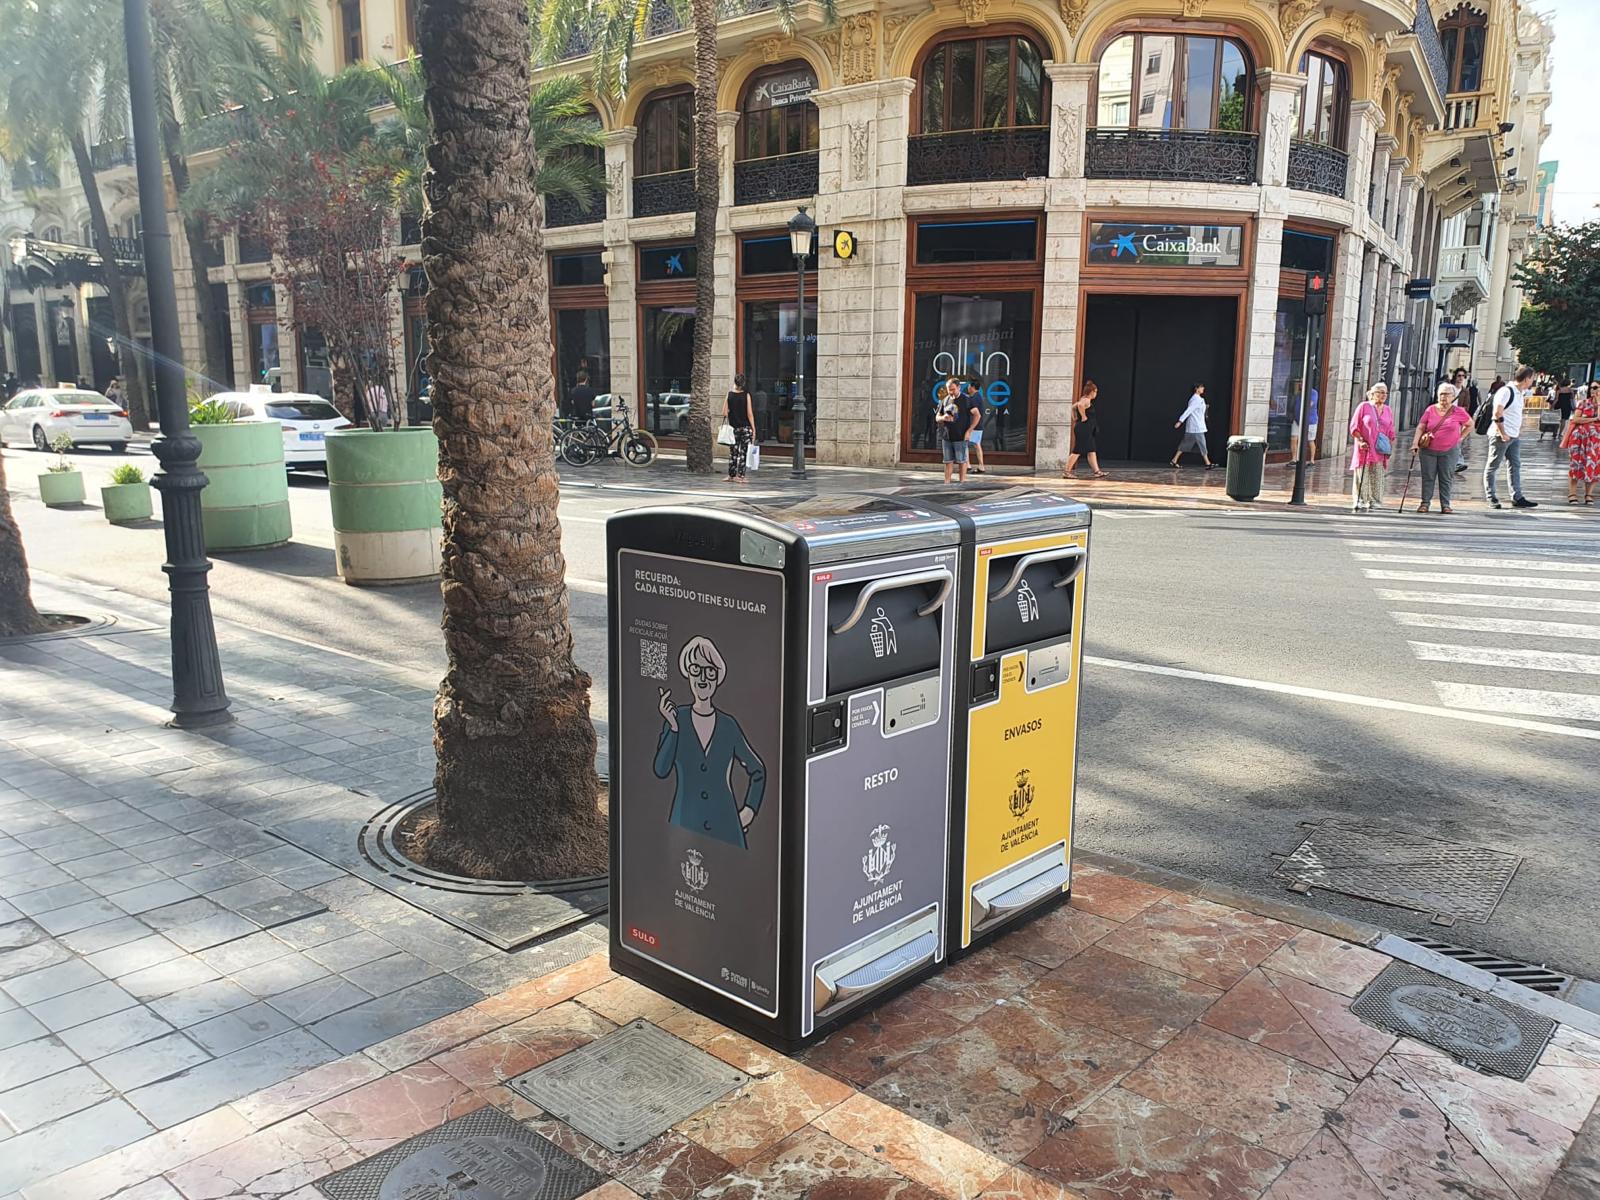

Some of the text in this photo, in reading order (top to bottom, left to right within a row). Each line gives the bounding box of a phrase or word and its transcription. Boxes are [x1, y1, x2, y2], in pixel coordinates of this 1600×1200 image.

[771, 77, 811, 93] CaixaBank
[1143, 235, 1221, 252] CaixaBank
[635, 569, 681, 585] RECUERDA:
[634, 582, 767, 614] CADA RESIDUO TIENE SU LUGAR
[1004, 718, 1042, 740] ENVASOS
[864, 767, 899, 790] RESTO
[1001, 818, 1039, 841] AJUNTAMENT
[1000, 842, 1009, 852] DE
[675, 890, 716, 911] AJUNTAMENT
[675, 898, 683, 908] DE
[853, 880, 903, 911] AJUNTAMENT
[852, 892, 903, 924] DE VALÈNCIA
[632, 928, 655, 944] SULO
[463, 1138, 515, 1176] VALENCIA
[443, 1147, 522, 1197] AJUNTAMENT
[511, 1173, 535, 1188] DE
